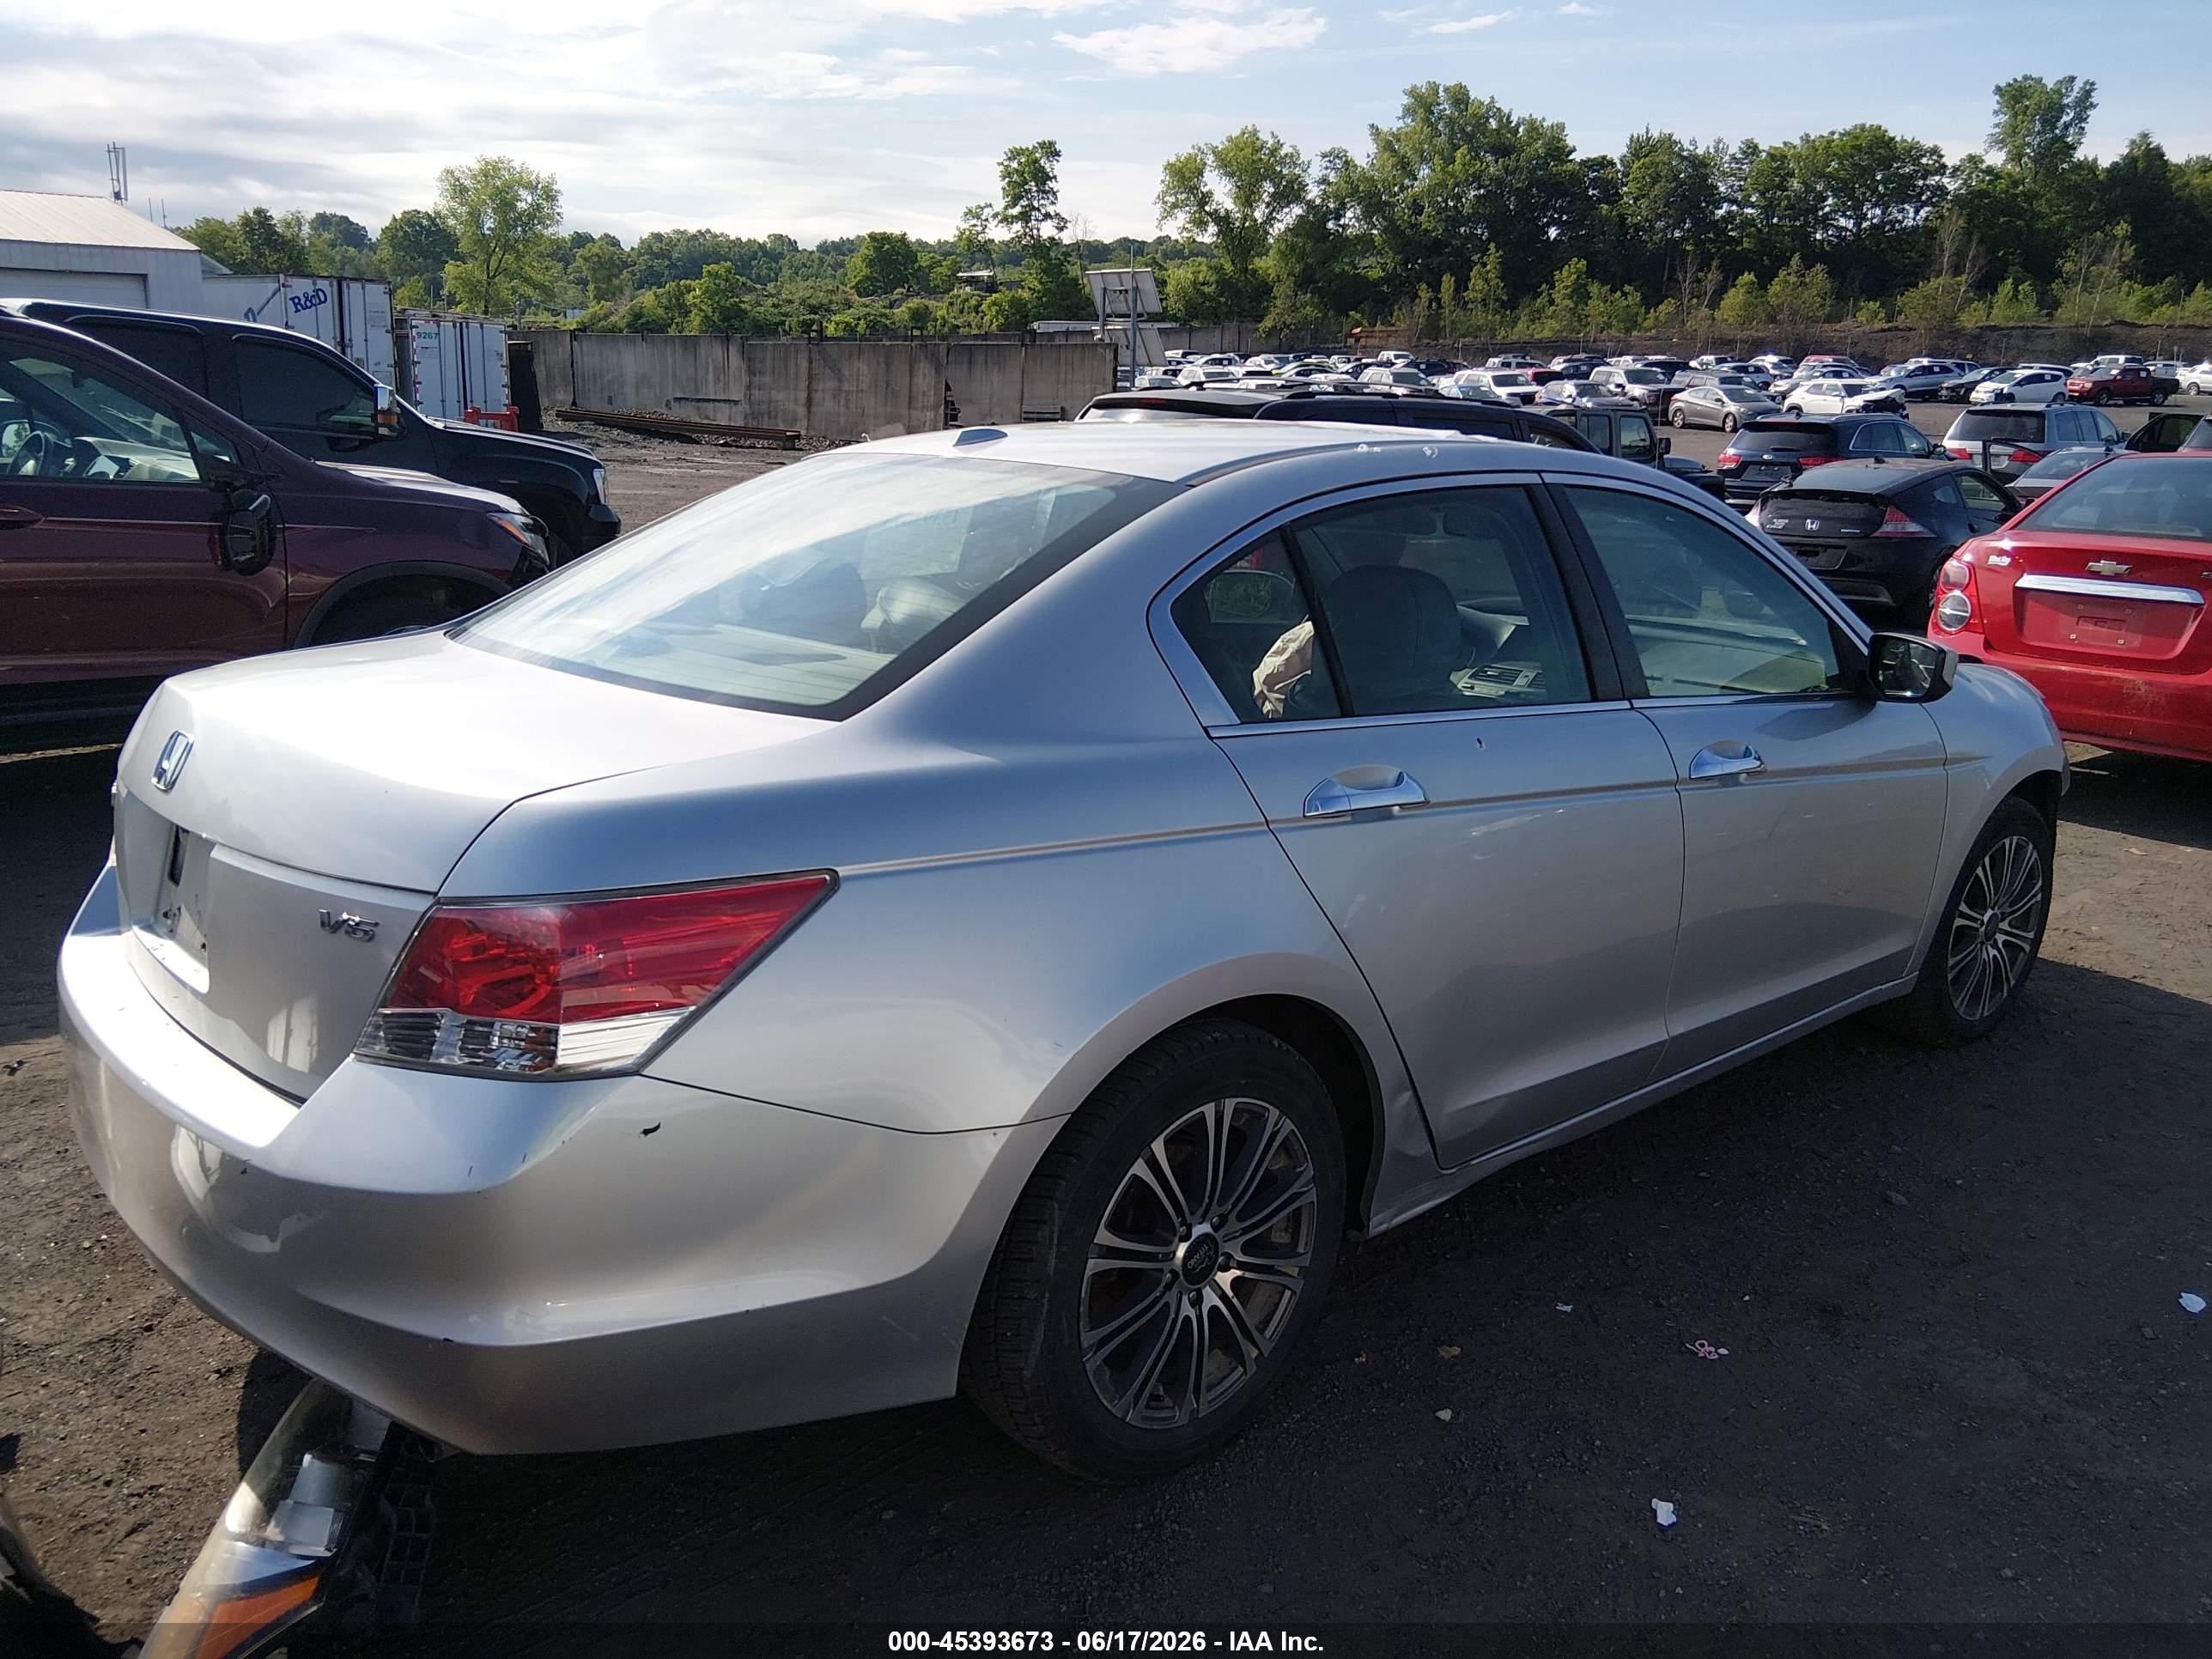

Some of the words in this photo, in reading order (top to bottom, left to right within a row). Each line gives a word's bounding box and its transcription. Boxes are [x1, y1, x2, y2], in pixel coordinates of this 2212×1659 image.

[289, 288, 328, 313] R&D
[416, 331, 439, 340] 9267
[319, 908, 380, 943] V6
